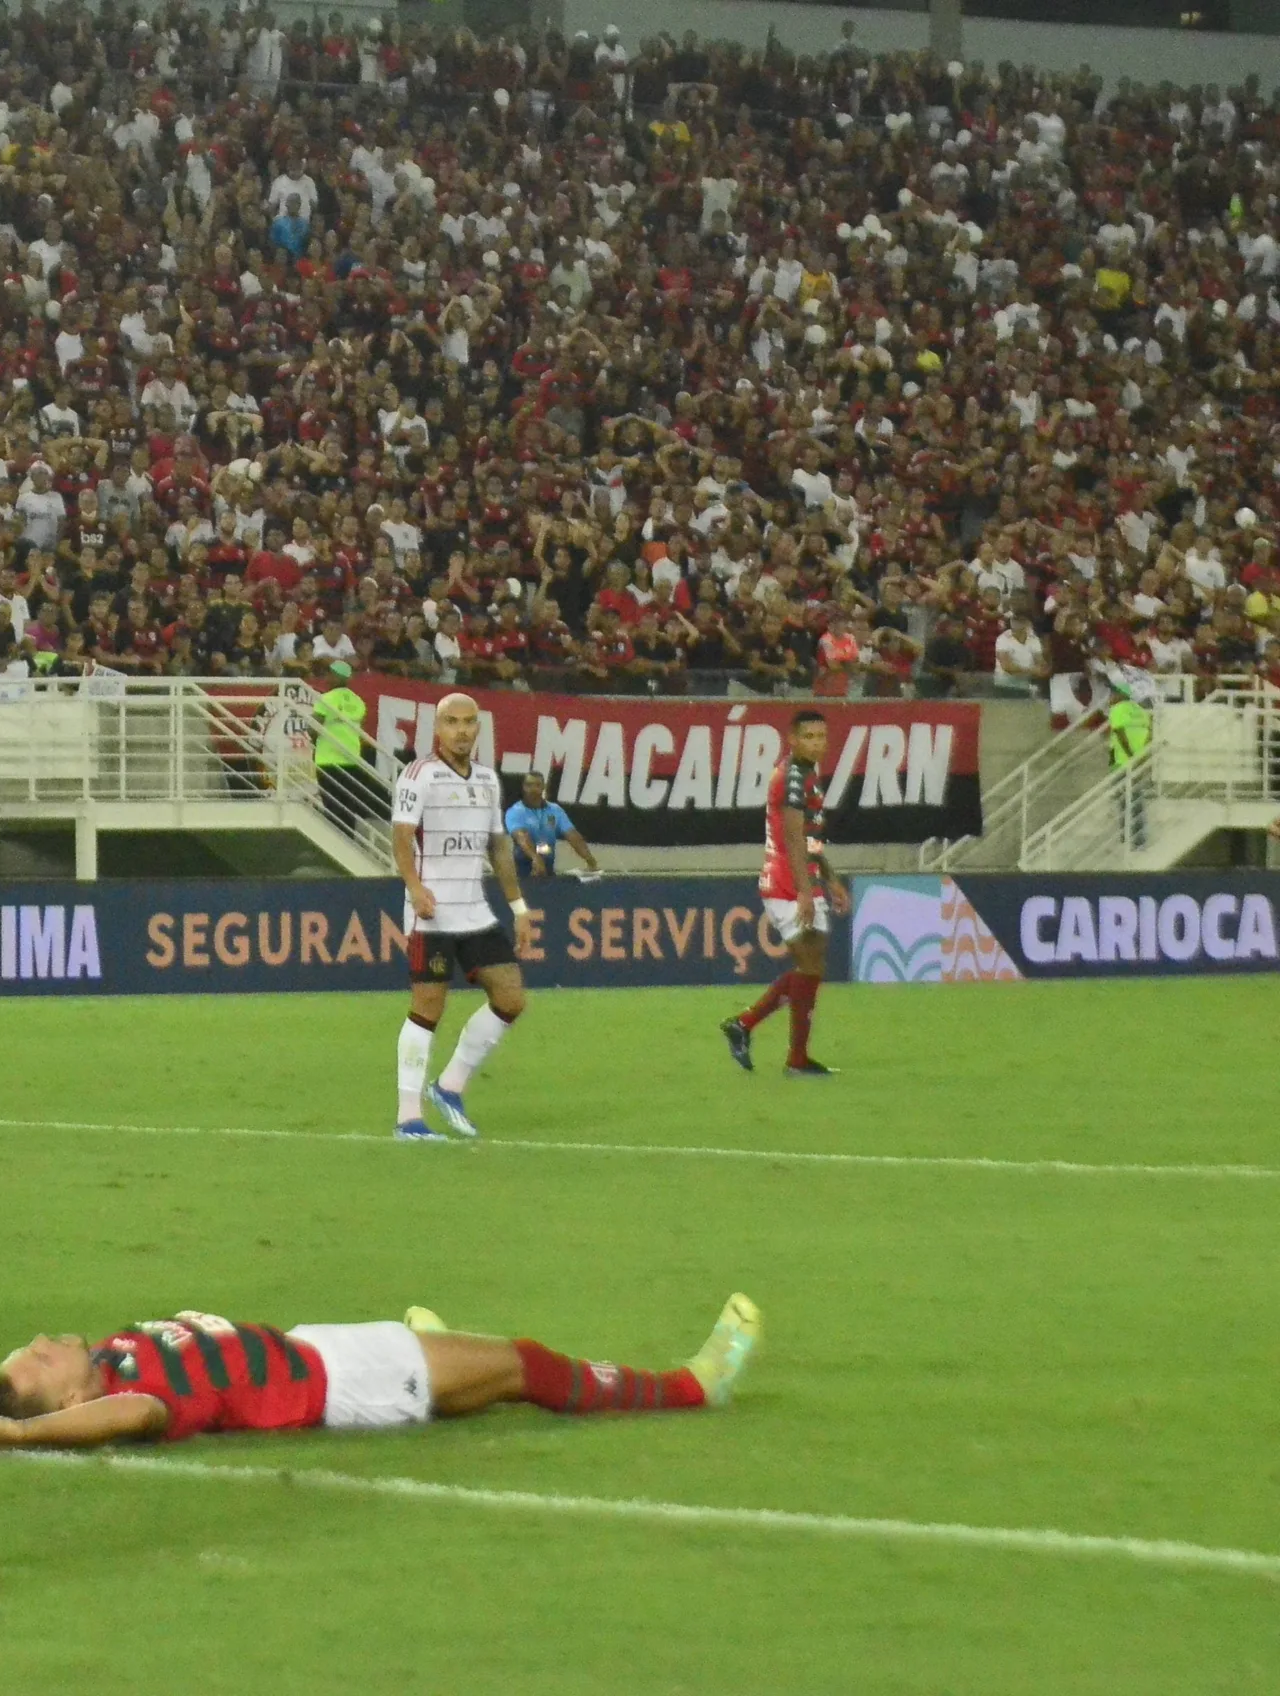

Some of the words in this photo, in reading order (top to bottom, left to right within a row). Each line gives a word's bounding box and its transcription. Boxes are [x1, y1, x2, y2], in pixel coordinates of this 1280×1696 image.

[146, 908, 411, 968] SEGURAN
[567, 905, 788, 975] SERVIÇO
[1020, 893, 1277, 963] CARIOCA
